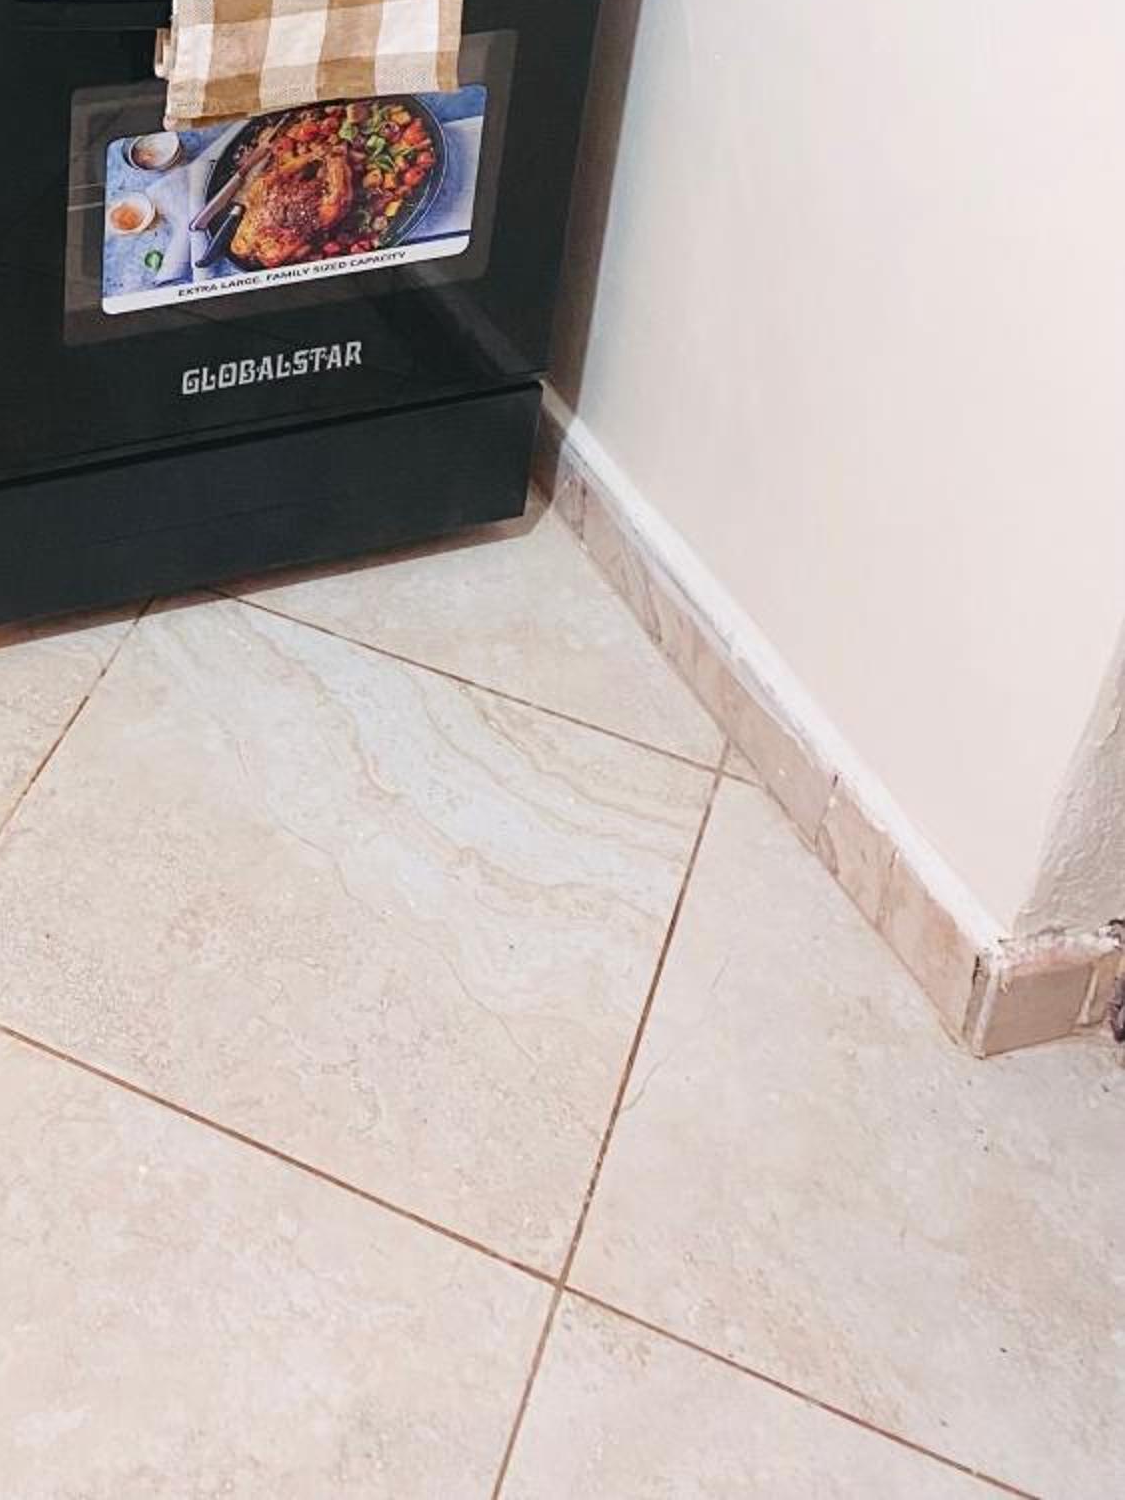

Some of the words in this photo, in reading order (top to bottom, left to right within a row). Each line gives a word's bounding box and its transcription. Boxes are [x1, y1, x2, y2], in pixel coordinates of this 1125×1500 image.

[178, 284, 218, 298] EXTRA
[266, 269, 310, 282] FAMILY
[314, 262, 346, 274] SIZED
[351, 252, 406, 267] CAPACITY
[182, 341, 362, 394] GLOBALSTAR
